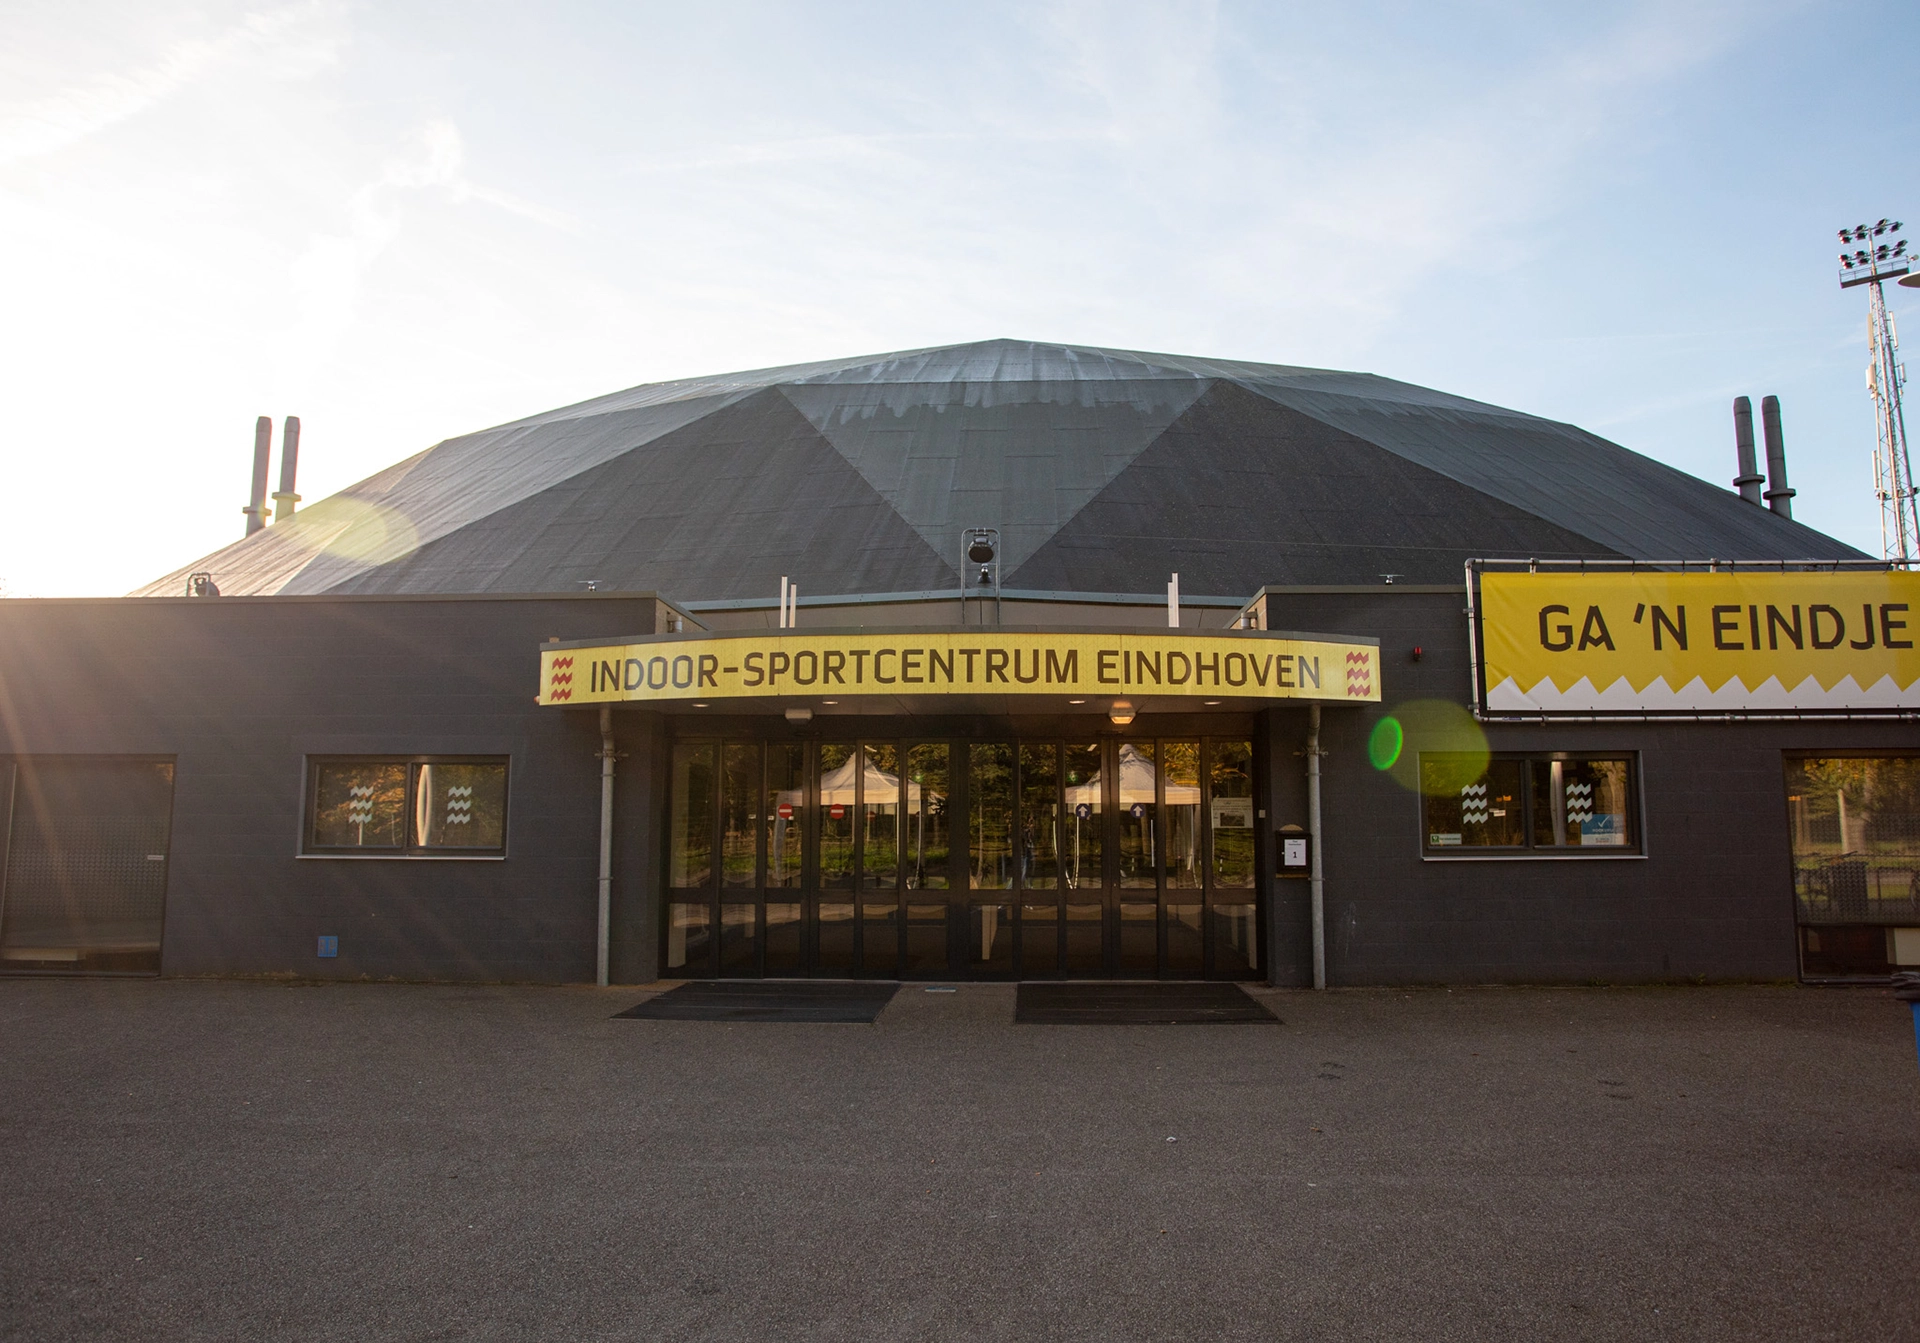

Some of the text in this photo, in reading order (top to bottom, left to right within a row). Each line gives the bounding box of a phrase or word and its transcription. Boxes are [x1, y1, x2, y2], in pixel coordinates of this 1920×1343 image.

[1539, 604, 1616, 652] GA
[1711, 602, 1914, 651] EINDJE
[590, 648, 1321, 693] INDOOR-SPORTCENTRUM EINDHOVEN
